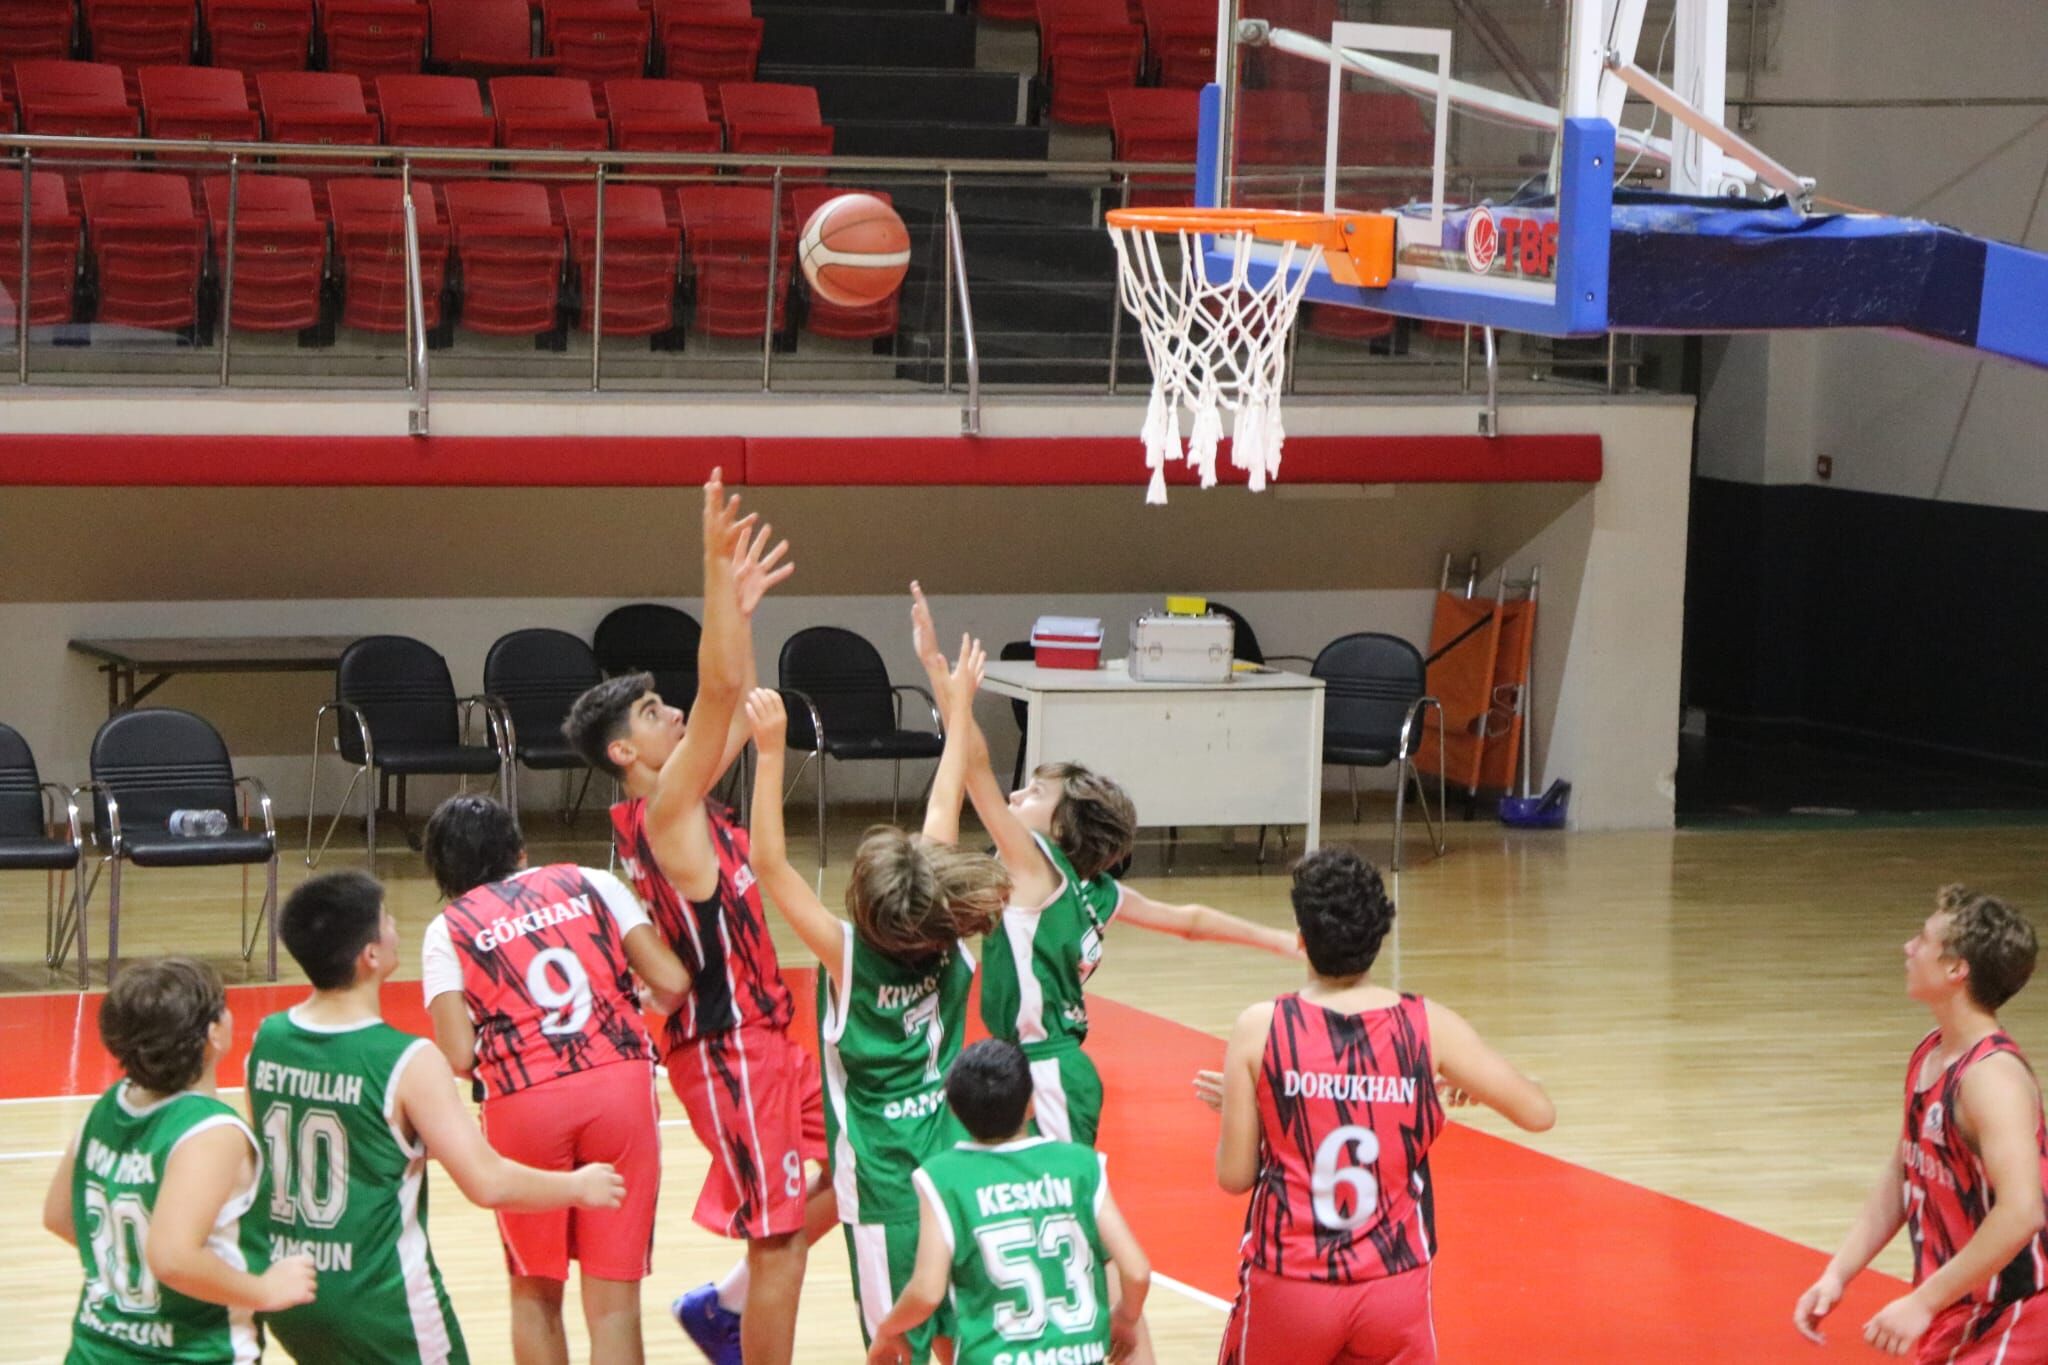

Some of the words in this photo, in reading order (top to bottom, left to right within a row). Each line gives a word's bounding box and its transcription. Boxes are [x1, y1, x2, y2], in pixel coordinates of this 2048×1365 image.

[1501, 217, 1559, 276] TBF
[475, 894, 592, 952] GÖKHAN
[527, 947, 593, 1034] 9
[904, 991, 945, 1083] 7
[255, 1060, 363, 1105] BEYTULLAH
[1284, 1070, 1417, 1104] DORUKHAN
[263, 1101, 349, 1229] 10
[782, 1150, 801, 1197] 8
[1311, 1125, 1380, 1231] 6
[976, 1172, 1073, 1218] KESKİN
[974, 1213, 1099, 1342] 53
